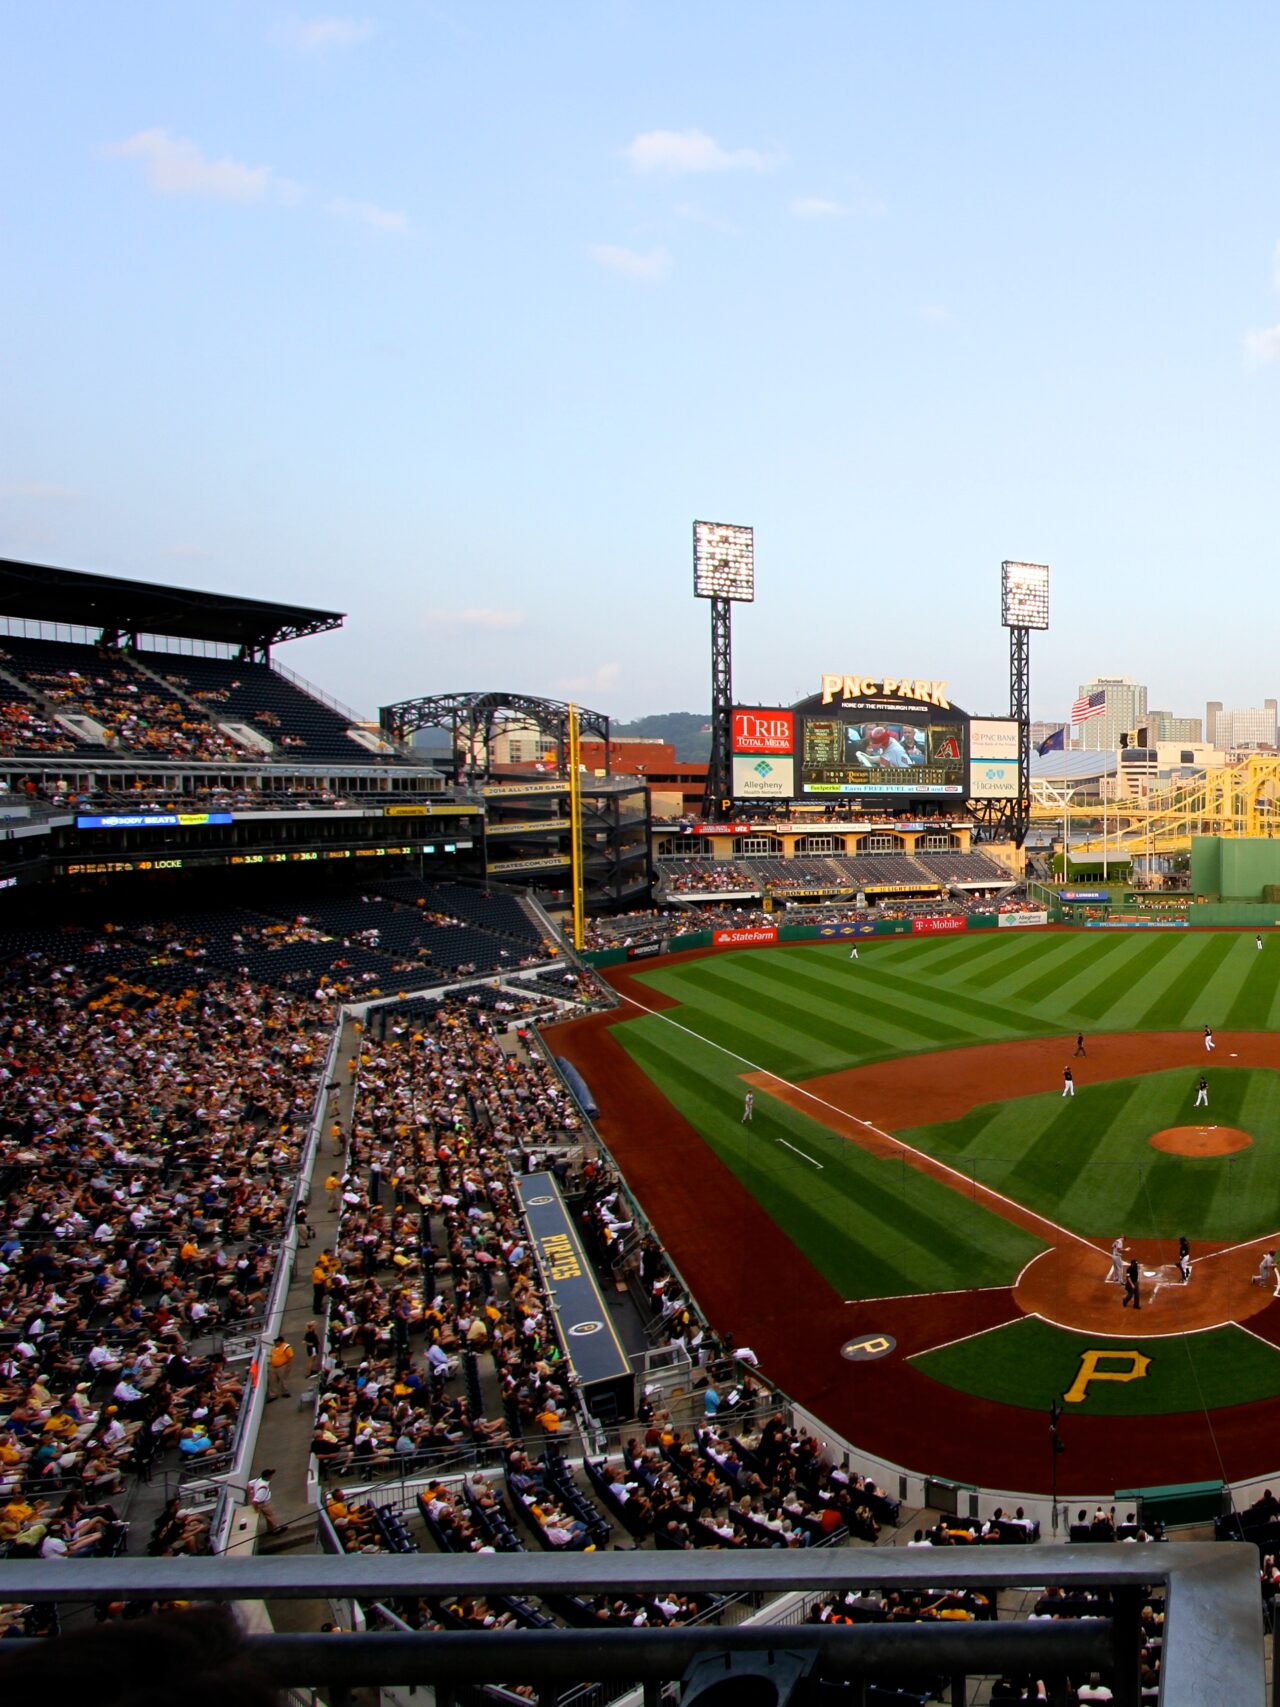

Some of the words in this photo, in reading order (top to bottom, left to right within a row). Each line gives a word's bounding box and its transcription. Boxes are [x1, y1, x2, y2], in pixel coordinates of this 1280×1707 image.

[822, 674, 878, 705] PNC
[882, 676, 950, 710] PARK
[736, 715, 789, 737] TRIB
[737, 737, 763, 746] TOTAL
[765, 738, 790, 748] MEDIA
[744, 781, 783, 790] Allegheny
[722, 800, 731, 810] P
[145, 816, 176, 824] BEATS
[155, 860, 182, 869] LOCKE
[245, 855, 264, 864] 3.50
[301, 852, 318, 860] 36.0
[540, 1233, 582, 1281] PIRATES
[846, 1337, 890, 1353] P
[1063, 1349, 1153, 1403] P
